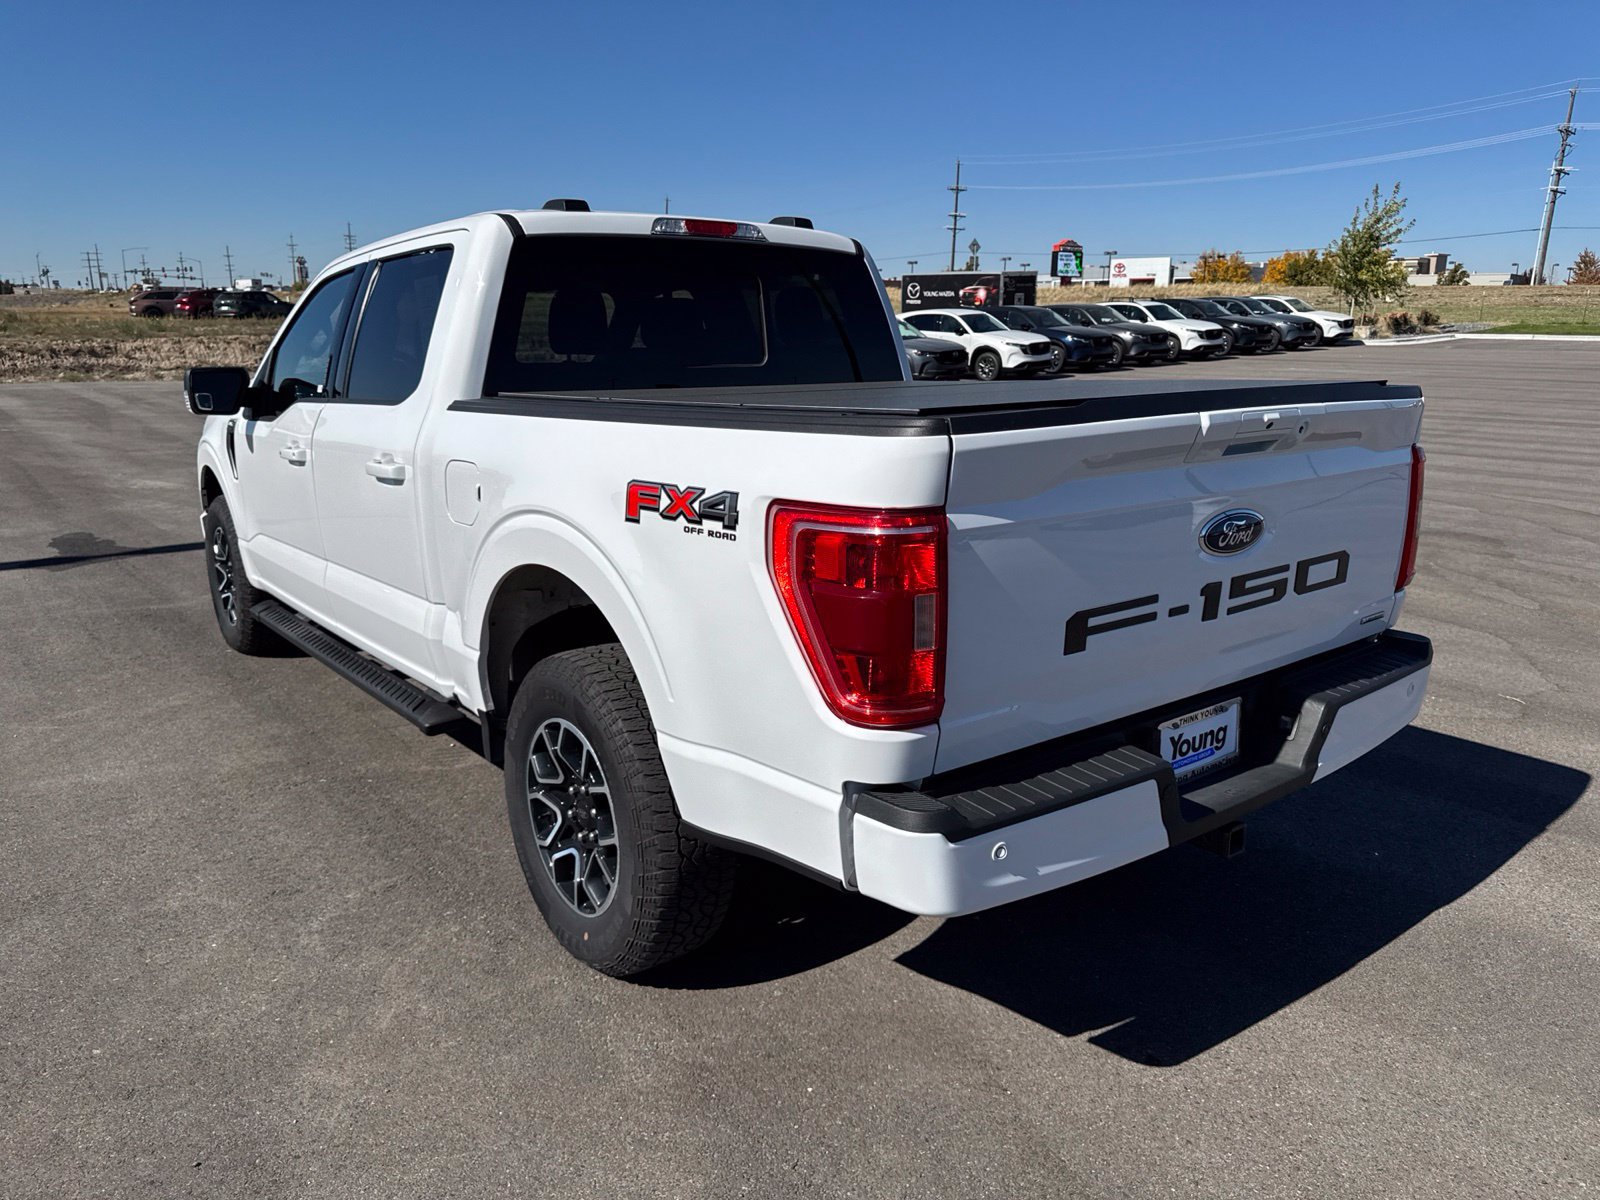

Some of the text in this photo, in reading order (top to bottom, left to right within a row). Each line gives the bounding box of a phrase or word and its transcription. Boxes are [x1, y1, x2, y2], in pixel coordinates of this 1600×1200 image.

[625, 479, 740, 531] FX4
[683, 525, 737, 541] OFF ROAD
[1218, 519, 1255, 547] Ford
[1063, 550, 1350, 656] F-150
[1179, 705, 1224, 726] THINK YOUNG
[1169, 724, 1228, 760] Young
